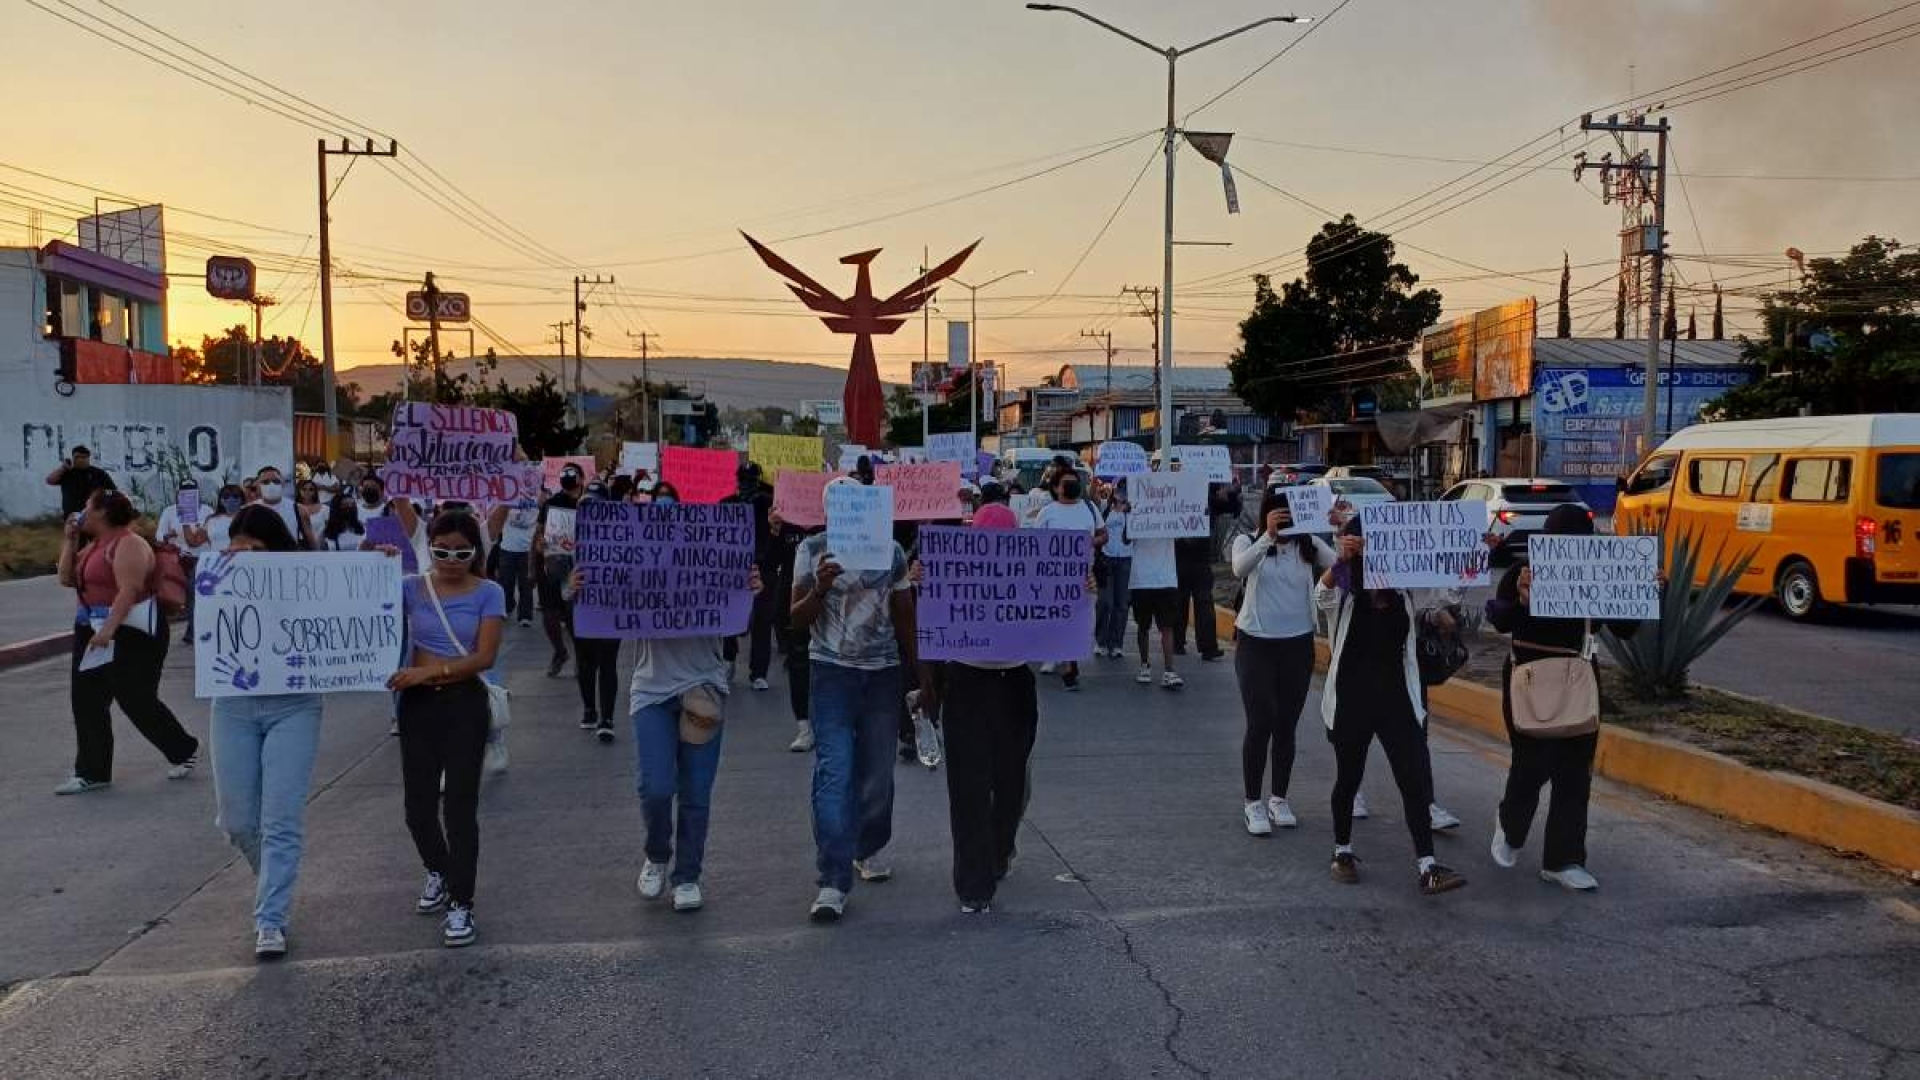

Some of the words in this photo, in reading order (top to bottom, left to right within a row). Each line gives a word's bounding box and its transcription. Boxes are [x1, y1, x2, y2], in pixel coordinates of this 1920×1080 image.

[393, 402, 422, 427] EL
[386, 471, 518, 501] COMPLICIDAD
[580, 502, 629, 522] TODAS
[635, 502, 708, 524] TENEMOS
[713, 503, 749, 524] UNA
[1364, 503, 1432, 526] DISCULPEN
[1439, 503, 1465, 526] LAS
[643, 525, 677, 541] QUE
[1365, 529, 1437, 551] MOLESTIAS
[1442, 528, 1478, 551] PERO
[919, 531, 989, 556] MARCHO
[995, 534, 1041, 558] PARA
[1531, 537, 1636, 561] MARCHAMOS
[576, 544, 645, 565] ABUSOS
[650, 547, 663, 563] Y
[672, 549, 753, 569] NINGUNO
[1364, 555, 1391, 574] NOS
[1395, 552, 1434, 573] ESTAN
[641, 569, 668, 590] UN
[676, 570, 745, 591] AMIGO
[919, 559, 940, 578] MI
[944, 560, 1026, 579] FAMILIA
[1036, 561, 1089, 578] RECIBA
[1532, 564, 1559, 581] POR
[1561, 564, 1588, 581] QUE
[1592, 563, 1657, 584] ESTAMOS
[231, 566, 330, 602] QUIERO
[343, 562, 398, 602] VIVIR
[918, 581, 941, 600] MI
[947, 583, 1017, 601] TITULO
[1030, 581, 1042, 601] Y
[1054, 584, 1081, 601] NO
[1569, 583, 1578, 600] Y
[1579, 584, 1600, 602] NO
[673, 590, 698, 610] NO
[706, 589, 730, 606] DA
[1537, 600, 1584, 616] HASTA
[1588, 602, 1650, 617] CUANDO
[614, 613, 641, 631] LA
[652, 609, 721, 630] CUENTA
[949, 603, 987, 623] MIS
[995, 604, 1071, 623] CENIZAS
[217, 604, 262, 656] NO
[271, 615, 398, 656] SOBREVIVIR
